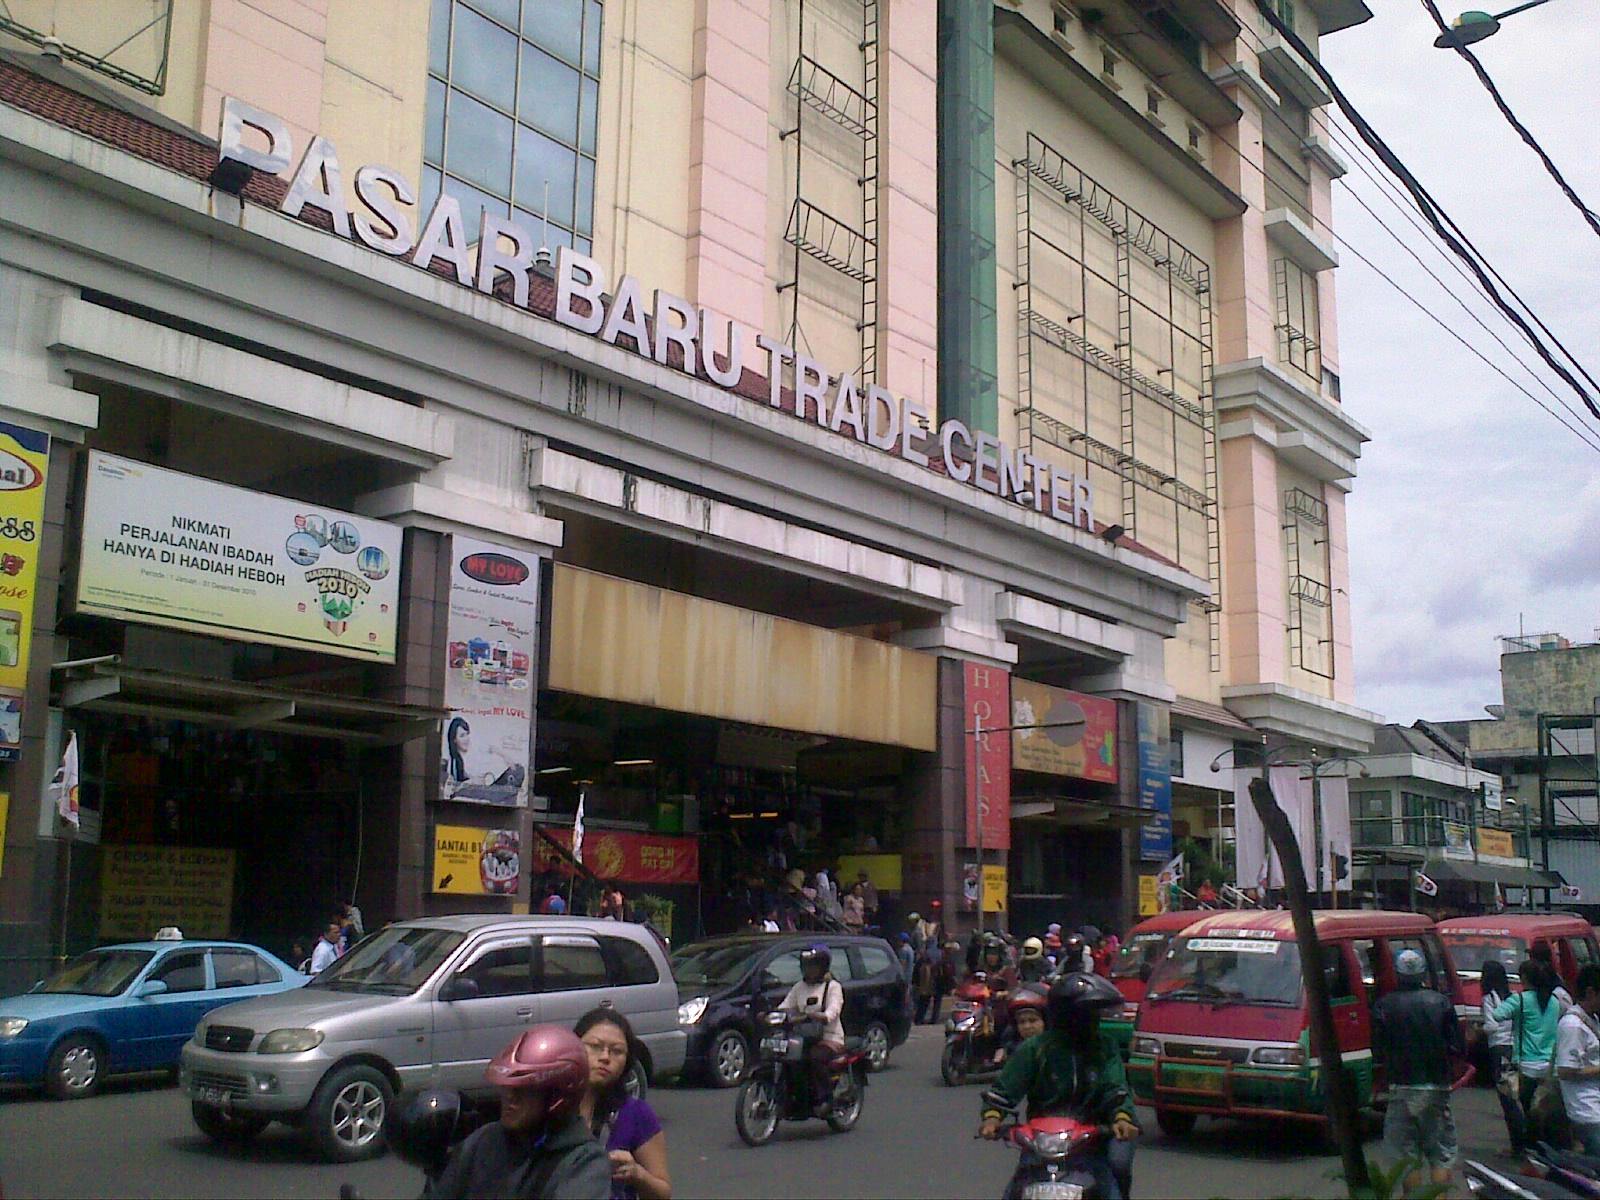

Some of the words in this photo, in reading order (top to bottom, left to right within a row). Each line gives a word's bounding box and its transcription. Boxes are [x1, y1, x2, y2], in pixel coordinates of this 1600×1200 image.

[219, 96, 533, 309] PASAR
[555, 245, 743, 388] BARU
[757, 335, 930, 468] TRADE
[939, 419, 1095, 533] CENTER
[172, 515, 231, 540] NIKMATI
[120, 522, 218, 555] PERJALANAN
[222, 545, 274, 566] IBADAH
[103, 538, 156, 561] HANYA
[160, 550, 175, 565] DI
[179, 554, 234, 576] HADIAH
[238, 565, 286, 587] HEBOH
[467, 556, 487, 576] MY
[489, 560, 523, 583] LOVE
[317, 577, 358, 598] 2010
[437, 839, 469, 853] LANTAI
